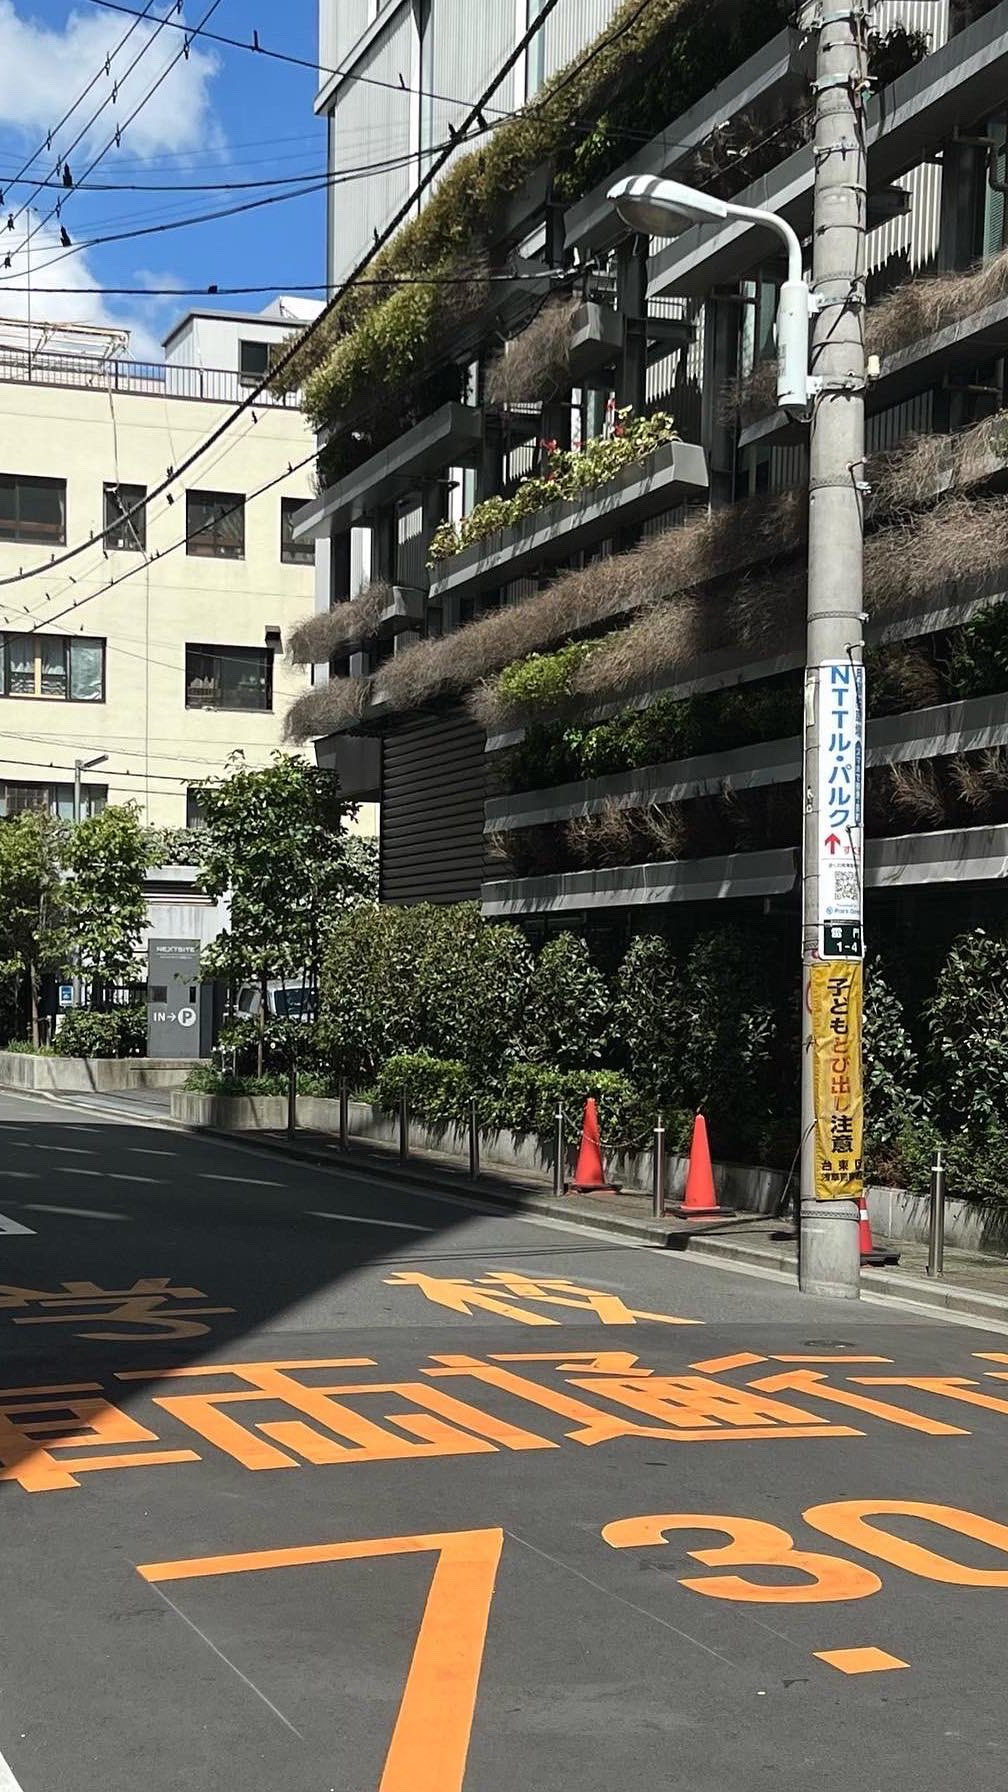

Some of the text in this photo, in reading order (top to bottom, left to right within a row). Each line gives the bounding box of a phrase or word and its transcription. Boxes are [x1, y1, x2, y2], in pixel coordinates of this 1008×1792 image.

[836, 941, 858, 953] 1-4
[153, 1012, 166, 1022] IN
[827, 977, 854, 1153] 子どもとび出し注意
